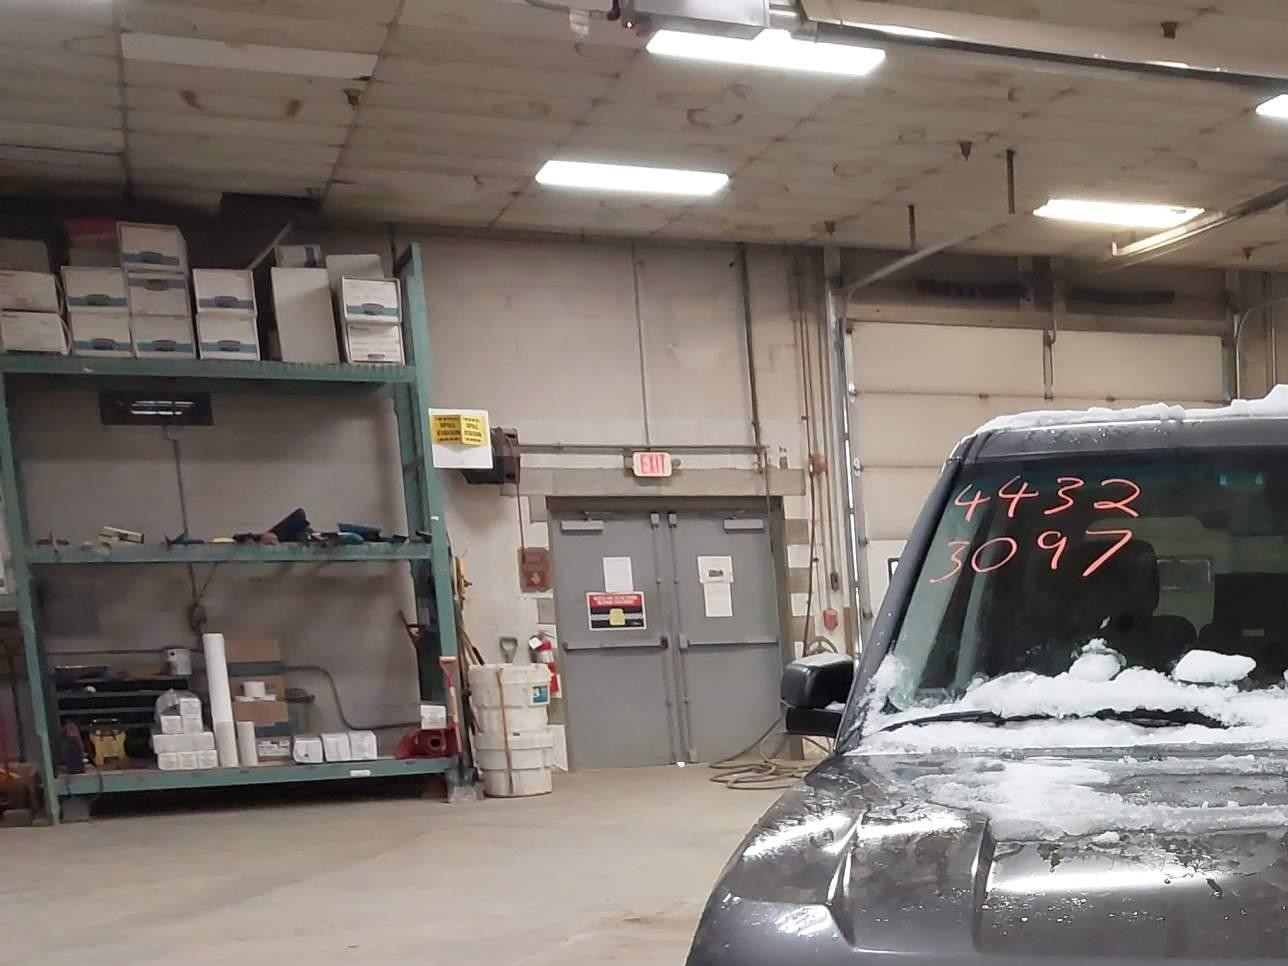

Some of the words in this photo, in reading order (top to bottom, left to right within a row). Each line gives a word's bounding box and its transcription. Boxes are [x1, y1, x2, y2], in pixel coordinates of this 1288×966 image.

[640, 453, 667, 474] EXIT
[954, 475, 1141, 522] 4432
[929, 530, 1133, 584] 3097
